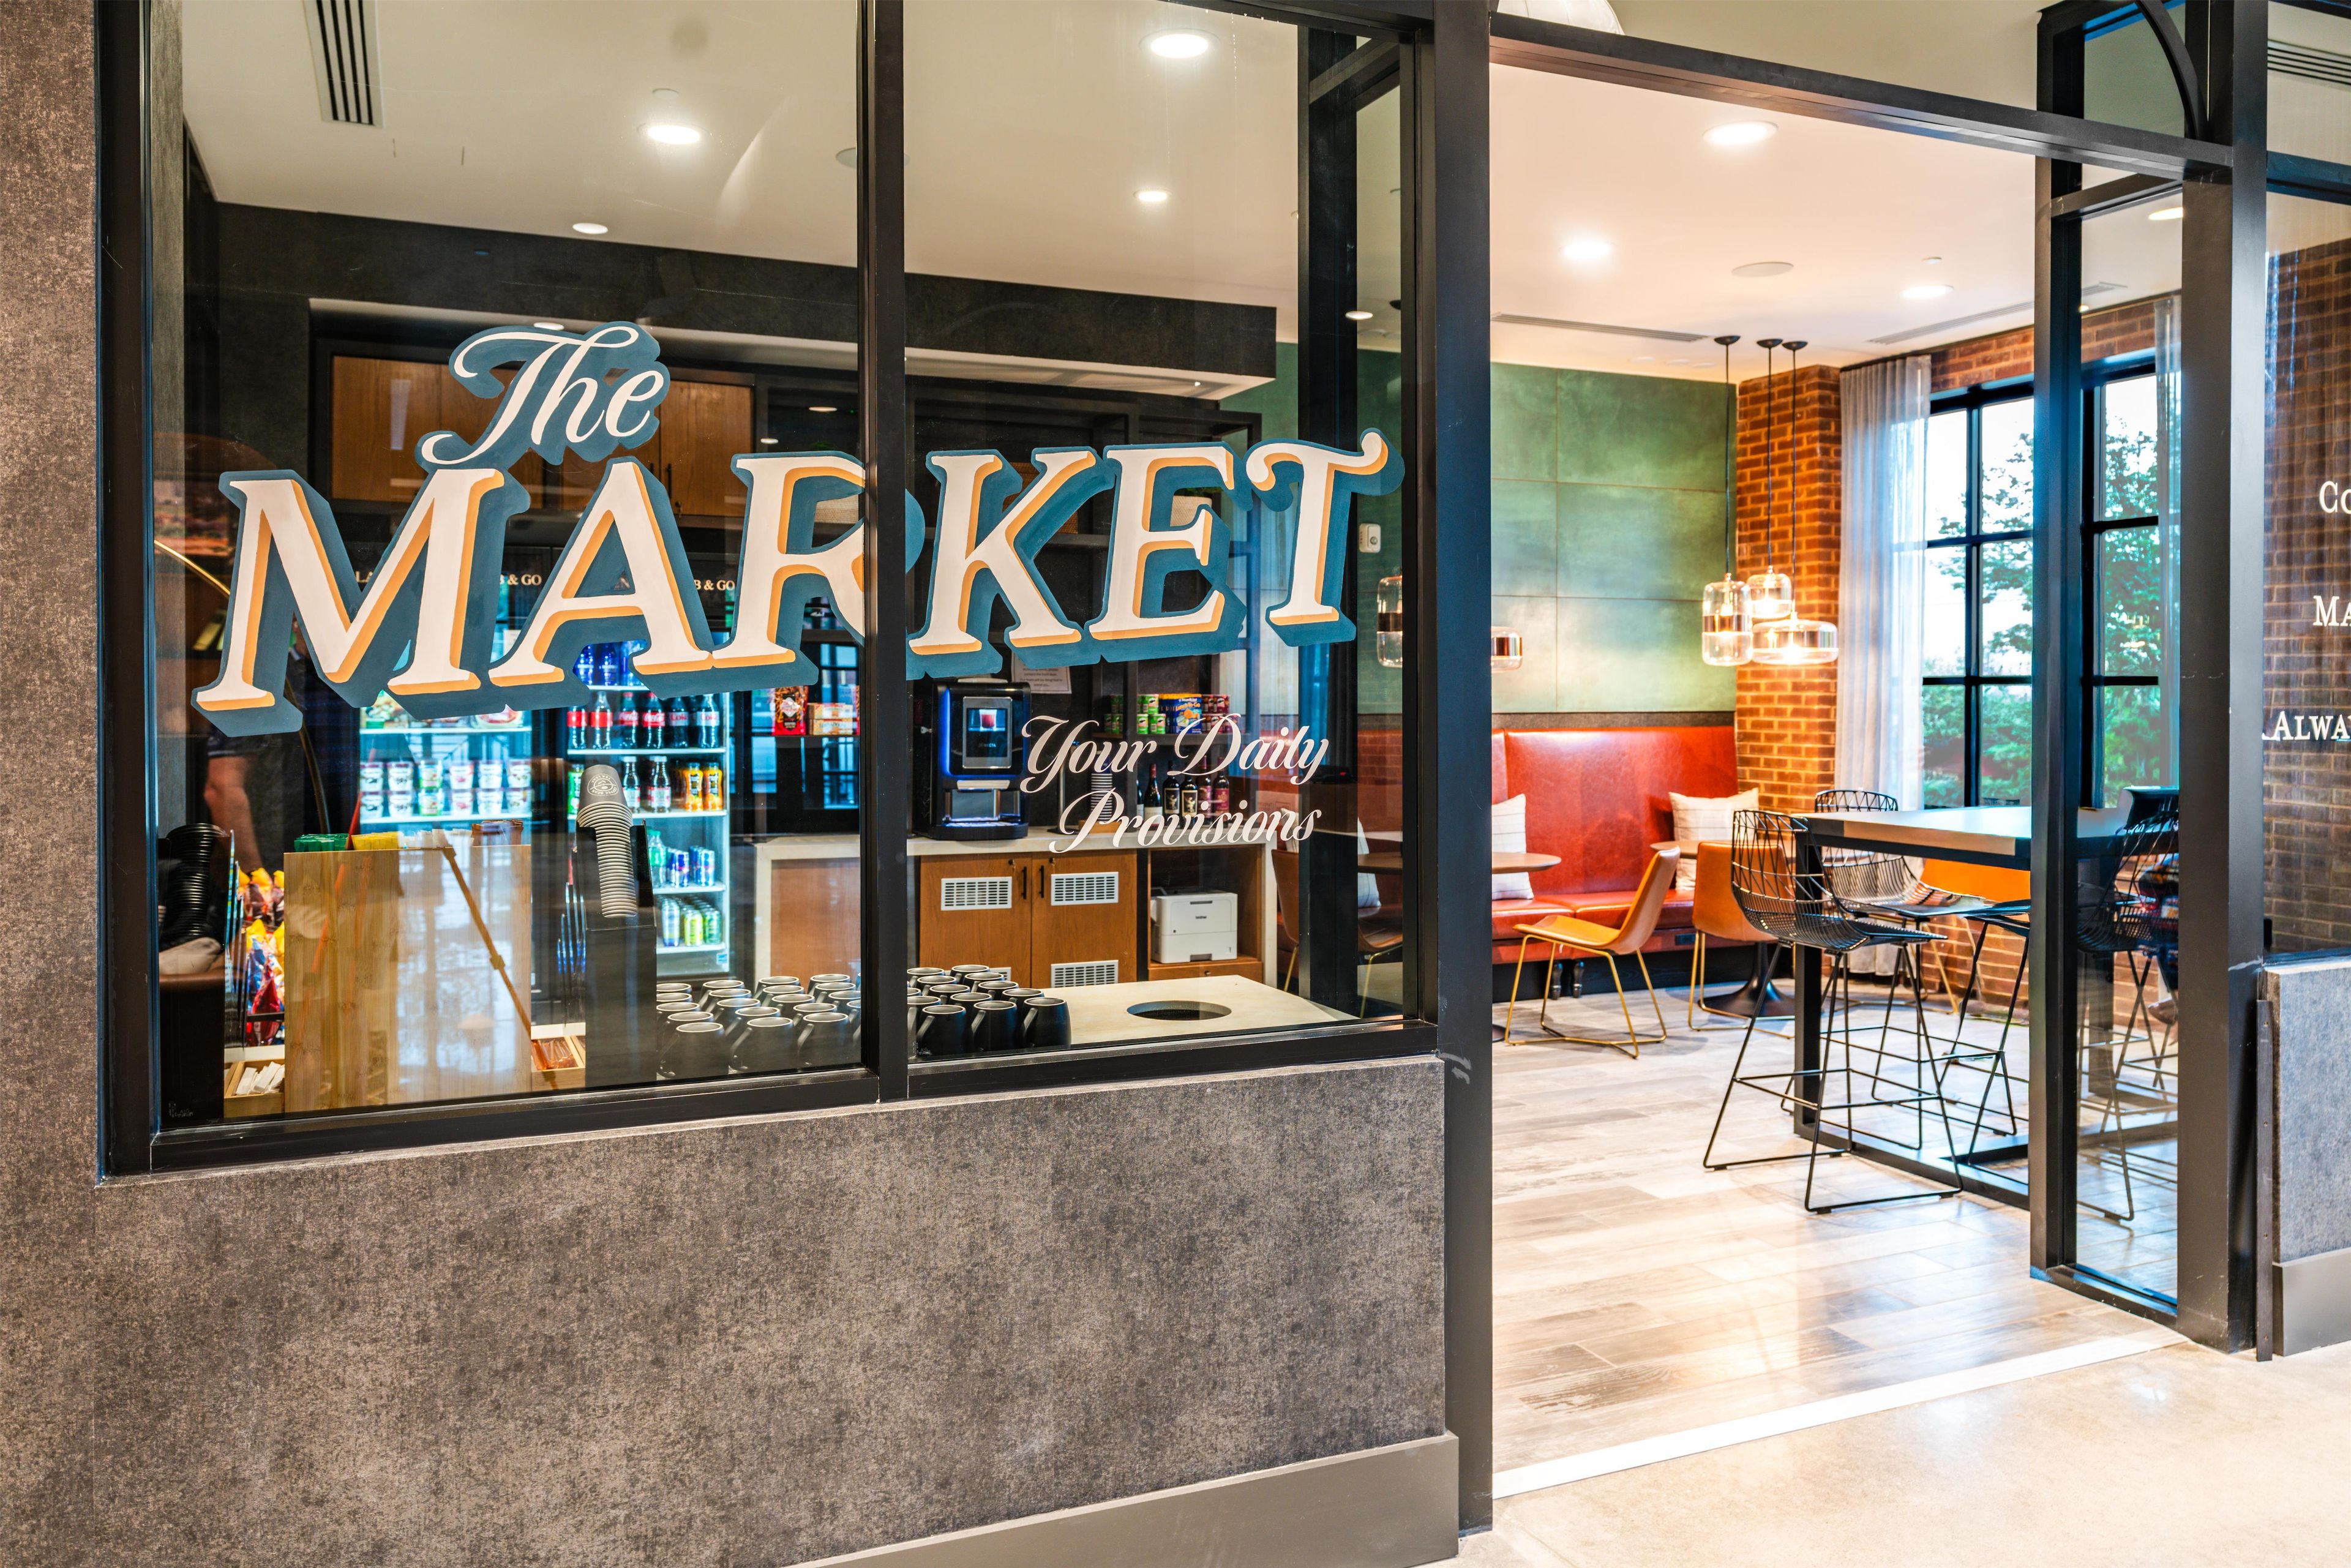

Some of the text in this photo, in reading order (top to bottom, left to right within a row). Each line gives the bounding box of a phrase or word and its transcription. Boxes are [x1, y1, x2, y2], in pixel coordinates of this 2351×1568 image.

[421, 326, 664, 465] The
[196, 431, 1389, 711] MARKET
[508, 574, 519, 585] &
[520, 574, 542, 586] GO
[703, 579, 714, 591] &
[716, 579, 735, 591] GO
[1019, 713, 1329, 793] Your Daily
[2271, 710, 2351, 741] ALWA
[1049, 787, 1322, 853] Provisions
